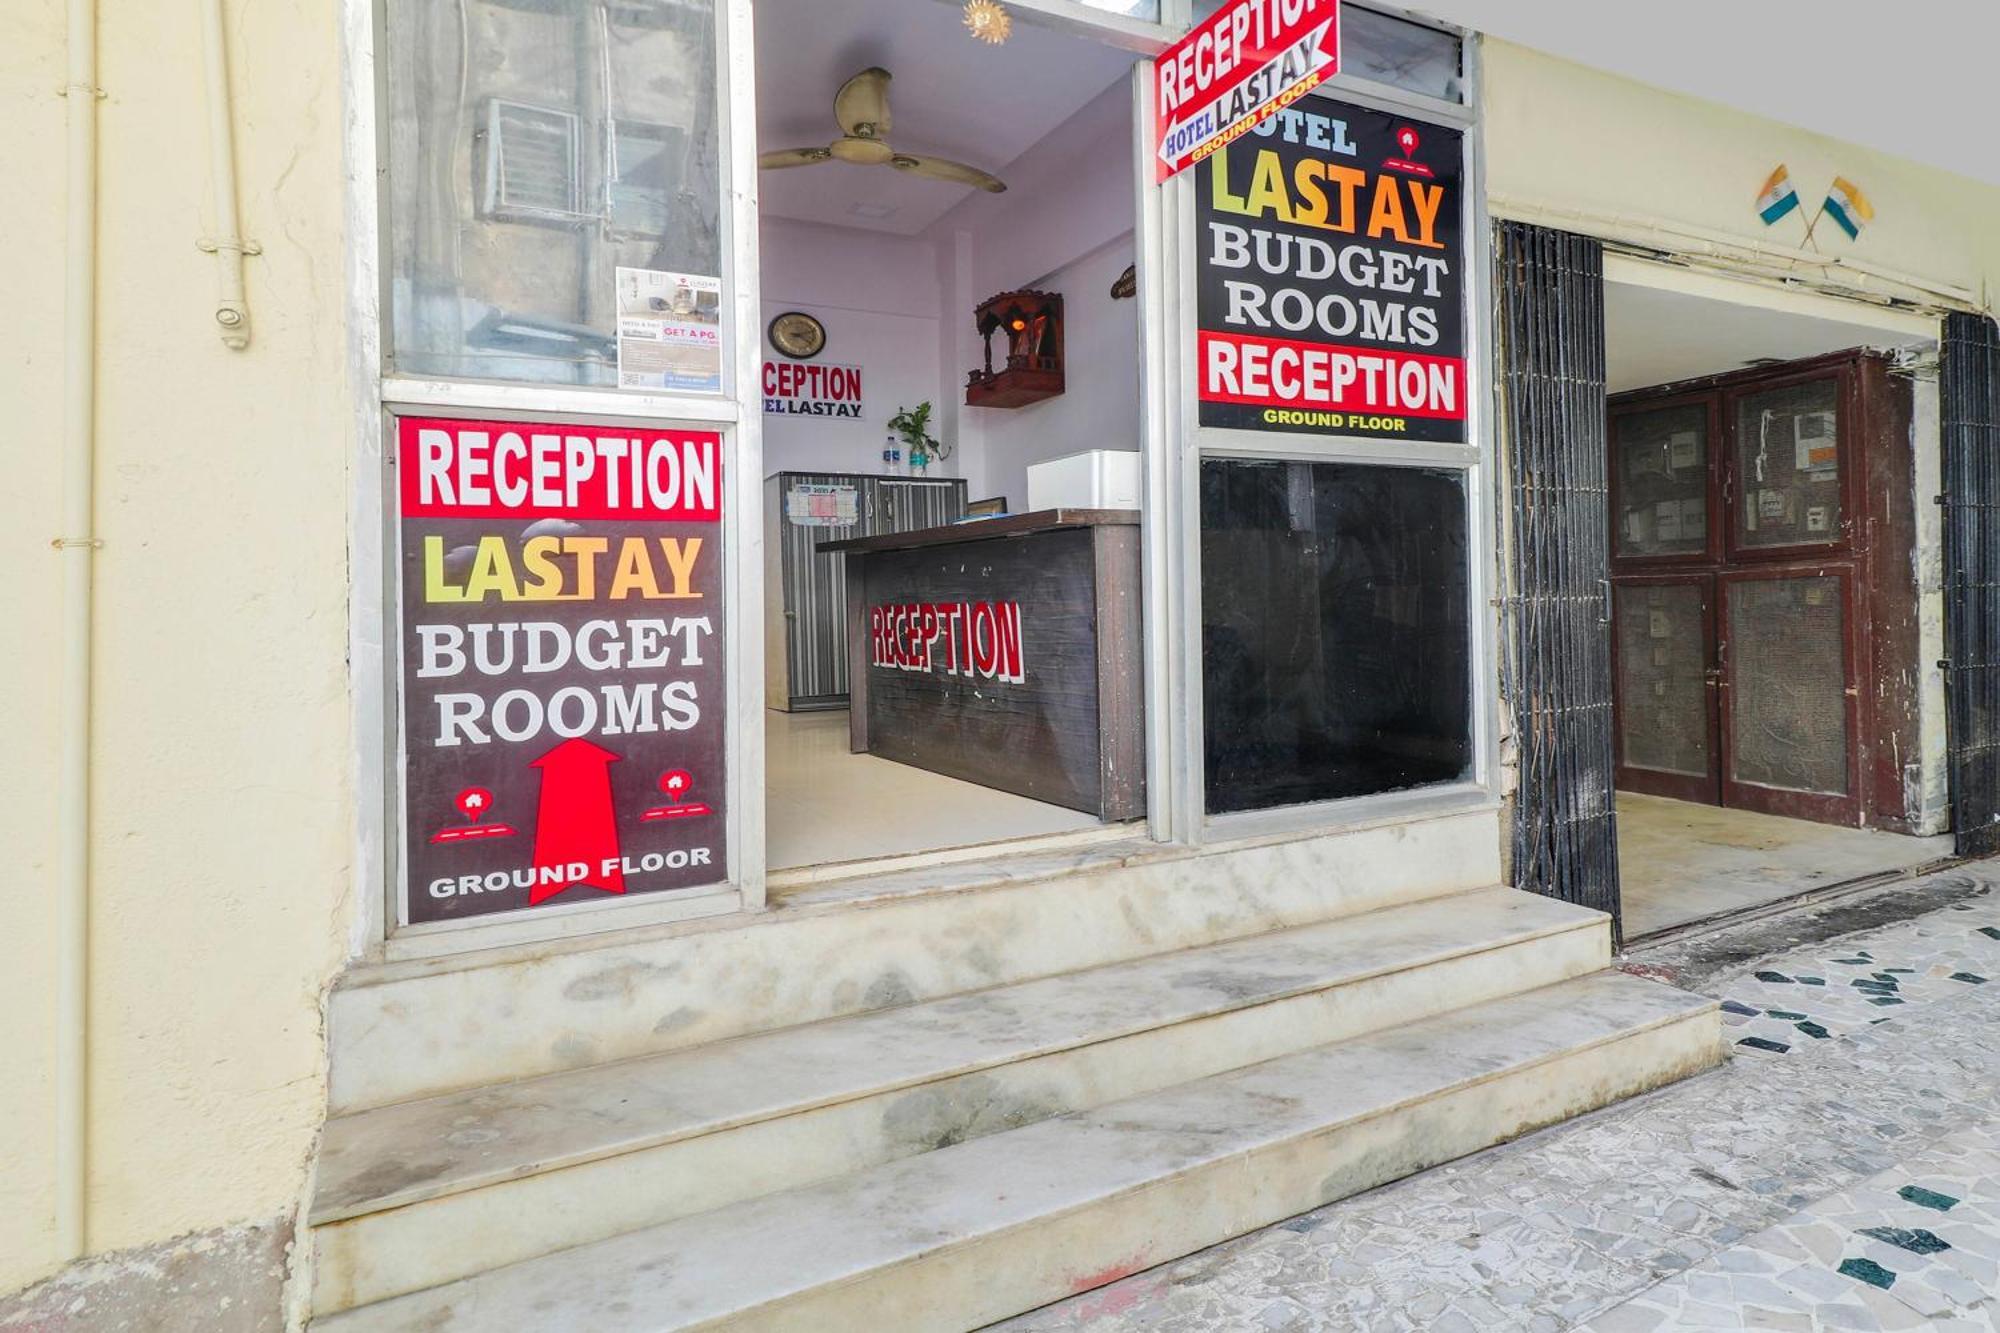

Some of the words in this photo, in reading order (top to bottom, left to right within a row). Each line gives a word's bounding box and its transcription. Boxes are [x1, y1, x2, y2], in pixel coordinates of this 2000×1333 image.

[1166, 112, 1214, 158] HOTEL
[1216, 31, 1318, 131] LASTAY
[1192, 114, 1256, 161] GROUND
[1261, 72, 1320, 117] FLOOR
[1211, 147, 1445, 249] LASTAY
[1209, 222, 1449, 298] BUDGET
[664, 328, 685, 336] GET
[1224, 280, 1440, 346] ROOMS
[788, 400, 862, 418] LASTAY
[1207, 340, 1455, 411] RECEPTION
[1263, 410, 1343, 427] GROUND
[1349, 416, 1405, 431] FLOOR
[418, 429, 714, 510] RECEPTION
[424, 535, 703, 603] LASTAY
[416, 617, 713, 678] BUDGET
[871, 600, 1025, 684] RECEPTION
[434, 681, 700, 746] ROOMS
[429, 862, 588, 898] GROUND
[602, 848, 711, 877] FLOOR
